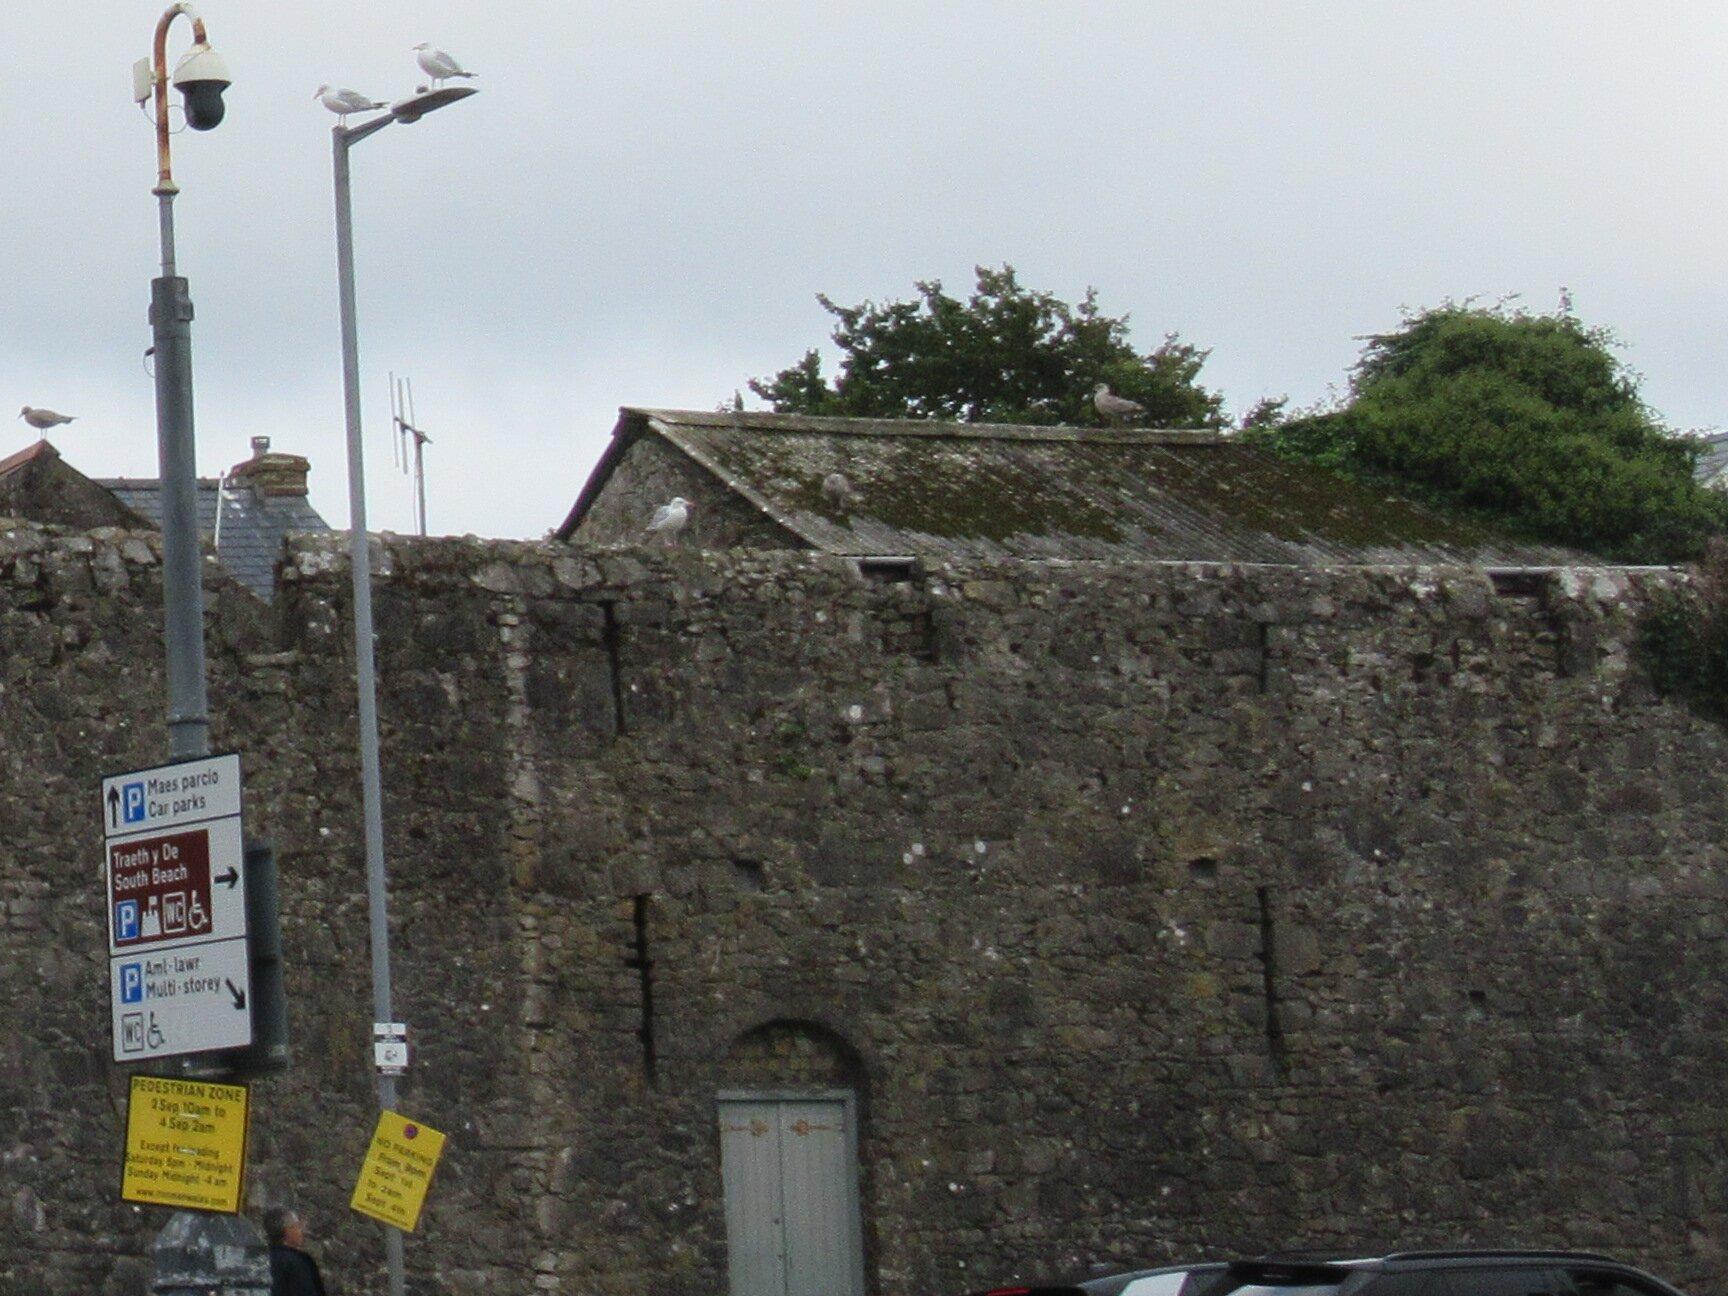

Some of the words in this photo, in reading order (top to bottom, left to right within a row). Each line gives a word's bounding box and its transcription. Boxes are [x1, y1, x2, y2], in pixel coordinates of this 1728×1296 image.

[148, 777, 178, 796] Maes
[182, 770, 219, 792] parcio
[148, 800, 169, 818] Car
[173, 795, 206, 816] parks
[114, 846, 149, 869] Traeth
[152, 850, 159, 865] y
[162, 842, 180, 861] De
[115, 872, 149, 891] South
[152, 863, 187, 885] Beach
[132, 1077, 205, 1098] PEDESTRIAN
[208, 1085, 242, 1102] ZONE
